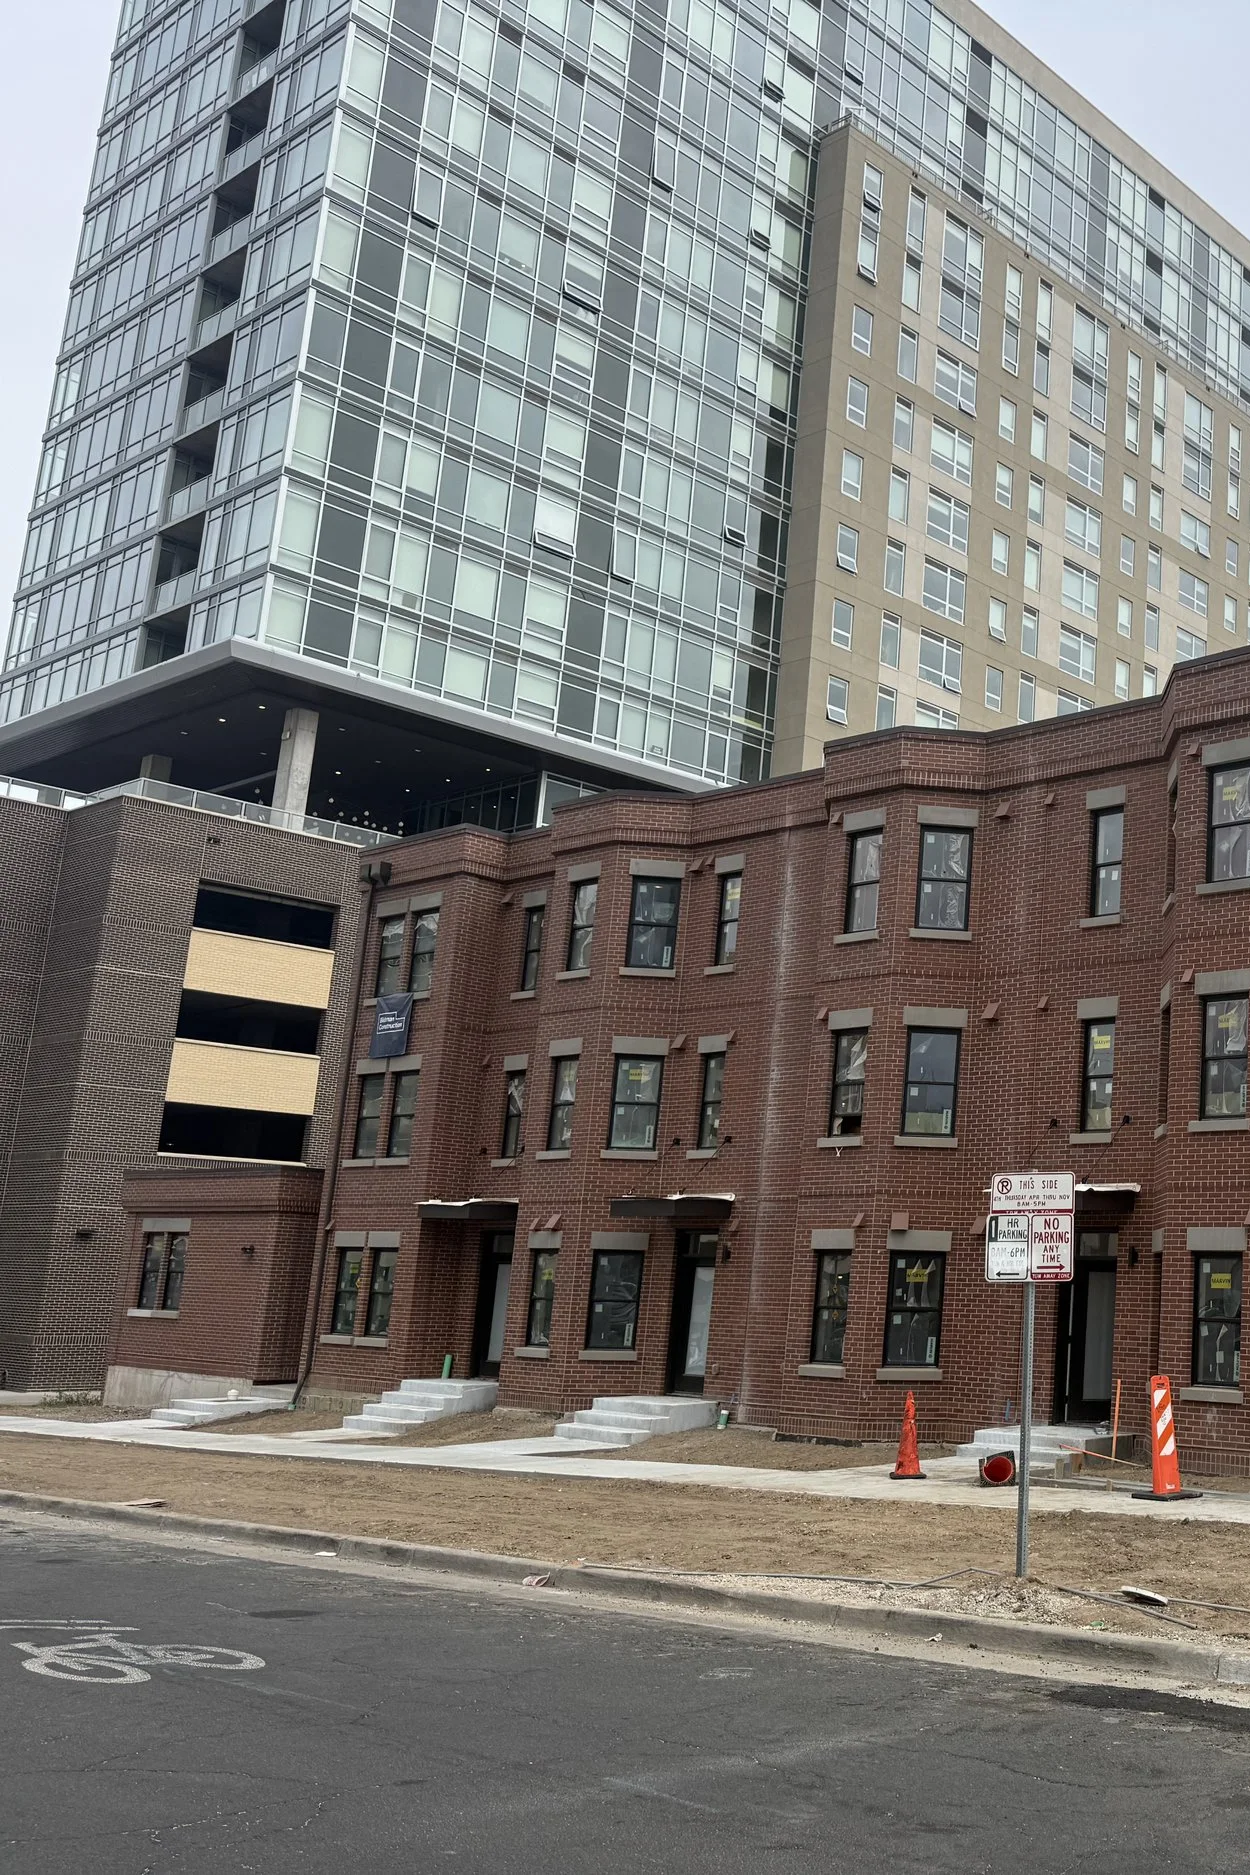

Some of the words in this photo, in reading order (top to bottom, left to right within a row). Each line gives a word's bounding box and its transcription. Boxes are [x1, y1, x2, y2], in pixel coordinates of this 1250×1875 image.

[1019, 1180, 1035, 1190] THIS
[1041, 1180, 1059, 1189] SIDE
[1007, 1218, 1019, 1228] HR
[1043, 1218, 1060, 1230] NO
[998, 1229, 1028, 1240] PARKING
[1033, 1231, 1070, 1244] PARKING
[1043, 1245, 1060, 1254] ANY
[1042, 1254, 1062, 1263] TIME
